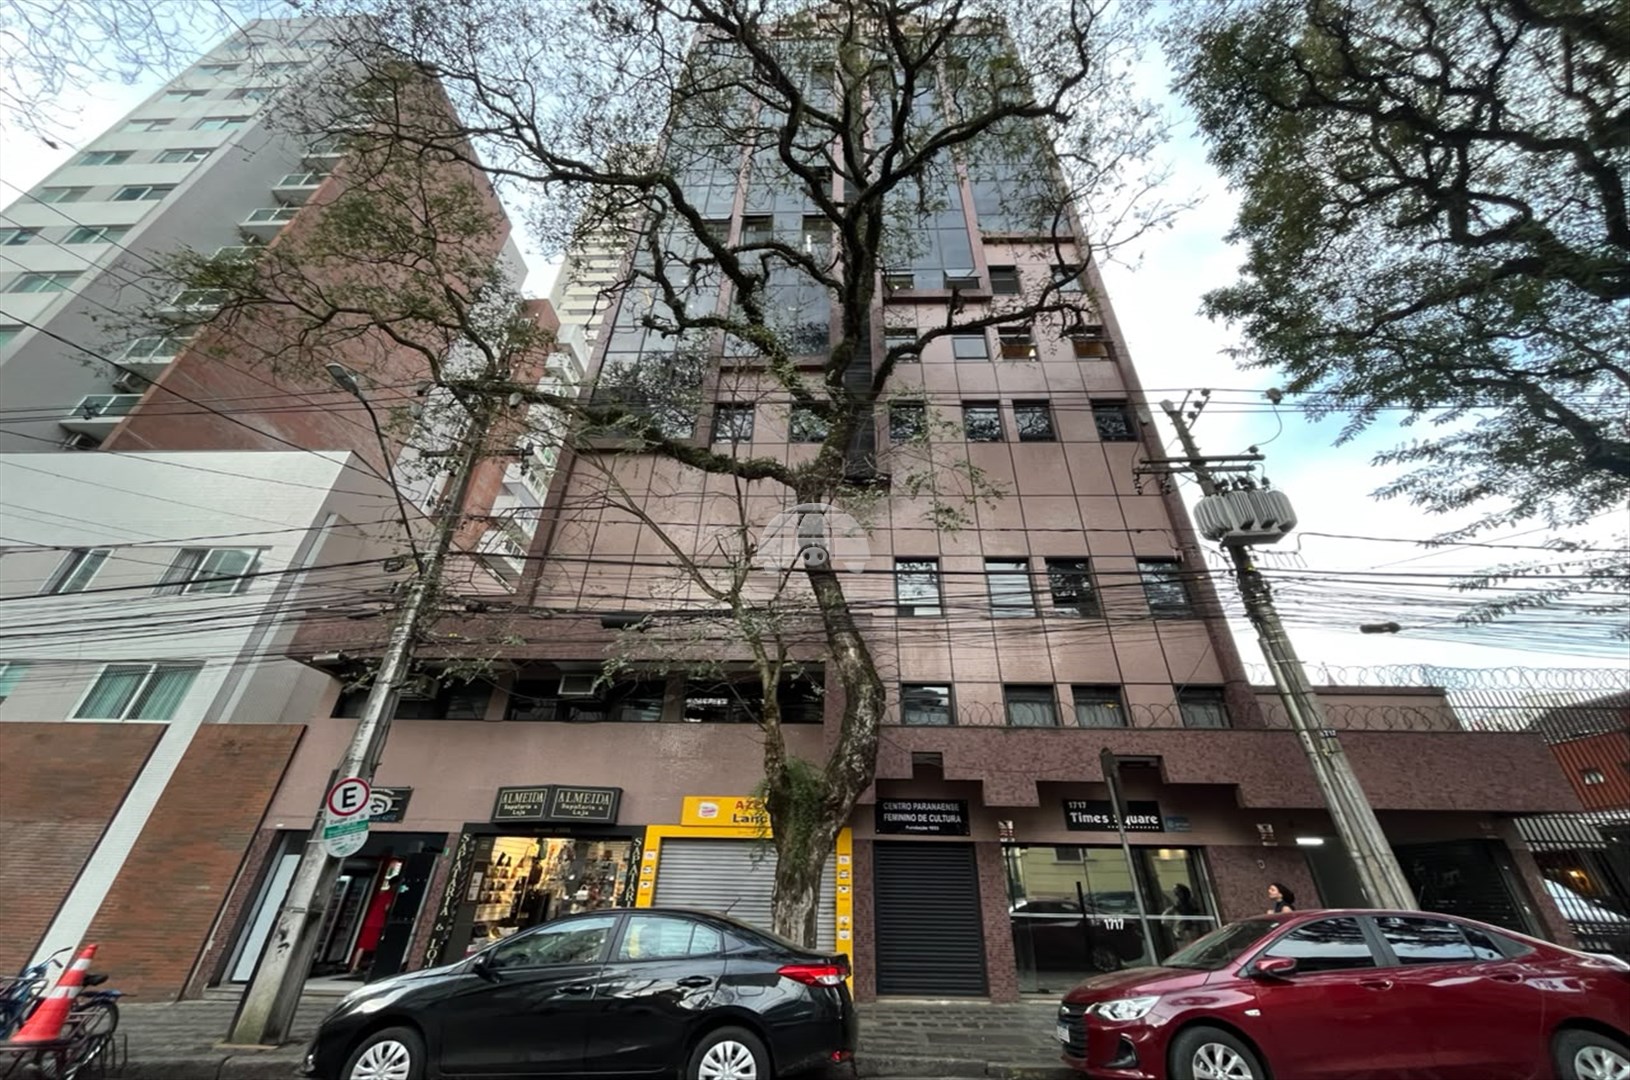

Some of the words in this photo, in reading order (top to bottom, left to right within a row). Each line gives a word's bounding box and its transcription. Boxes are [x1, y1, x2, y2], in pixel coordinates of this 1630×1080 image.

[342, 786, 357, 809] E
[502, 792, 544, 803] ALMEIDA
[558, 791, 609, 805] ALMEIDA
[883, 802, 912, 811] CENTRO
[913, 802, 960, 812] PARANAENSE
[1068, 801, 1087, 809] 1717
[732, 813, 768, 824] Lanc
[883, 813, 917, 823] FEMININO
[918, 813, 928, 823] DE
[929, 814, 962, 824] CULTURA
[1069, 812, 1109, 824] Times
[625, 837, 642, 908] SAPATARI
[1103, 918, 1124, 930] 1717
